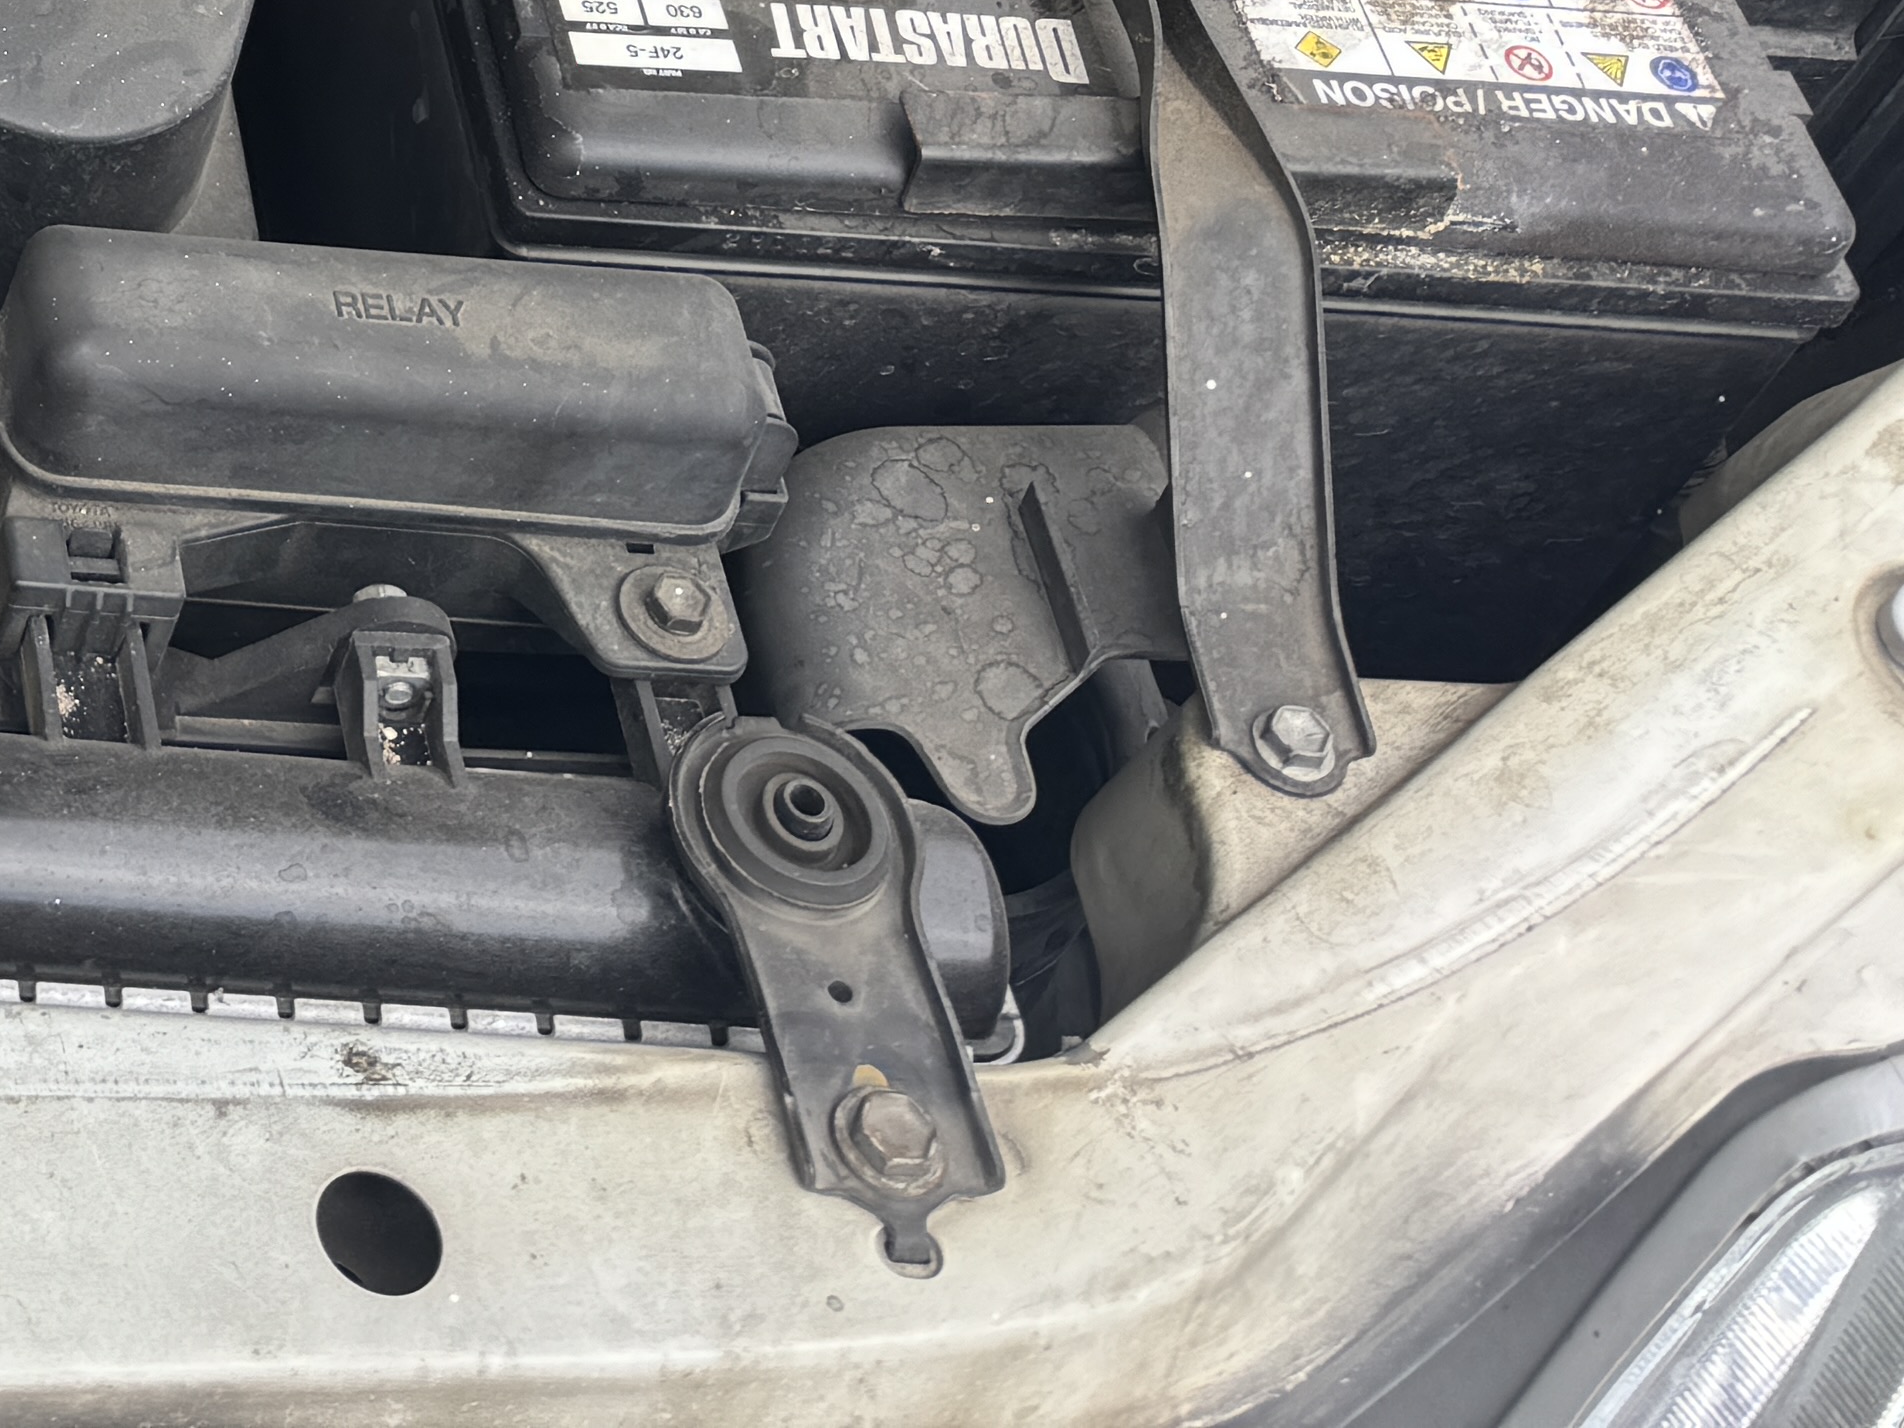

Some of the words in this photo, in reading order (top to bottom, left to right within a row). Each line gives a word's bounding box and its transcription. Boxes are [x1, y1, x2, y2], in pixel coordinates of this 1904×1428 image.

[581, 0, 618, 14] 525
[666, 4, 702, 18] 630
[626, 44, 684, 60] 24F-5
[769, 1, 1090, 86] DURASTART
[1315, 78, 1468, 112] POISON
[1497, 88, 1675, 129] DANGER
[331, 288, 466, 330] RELAY
